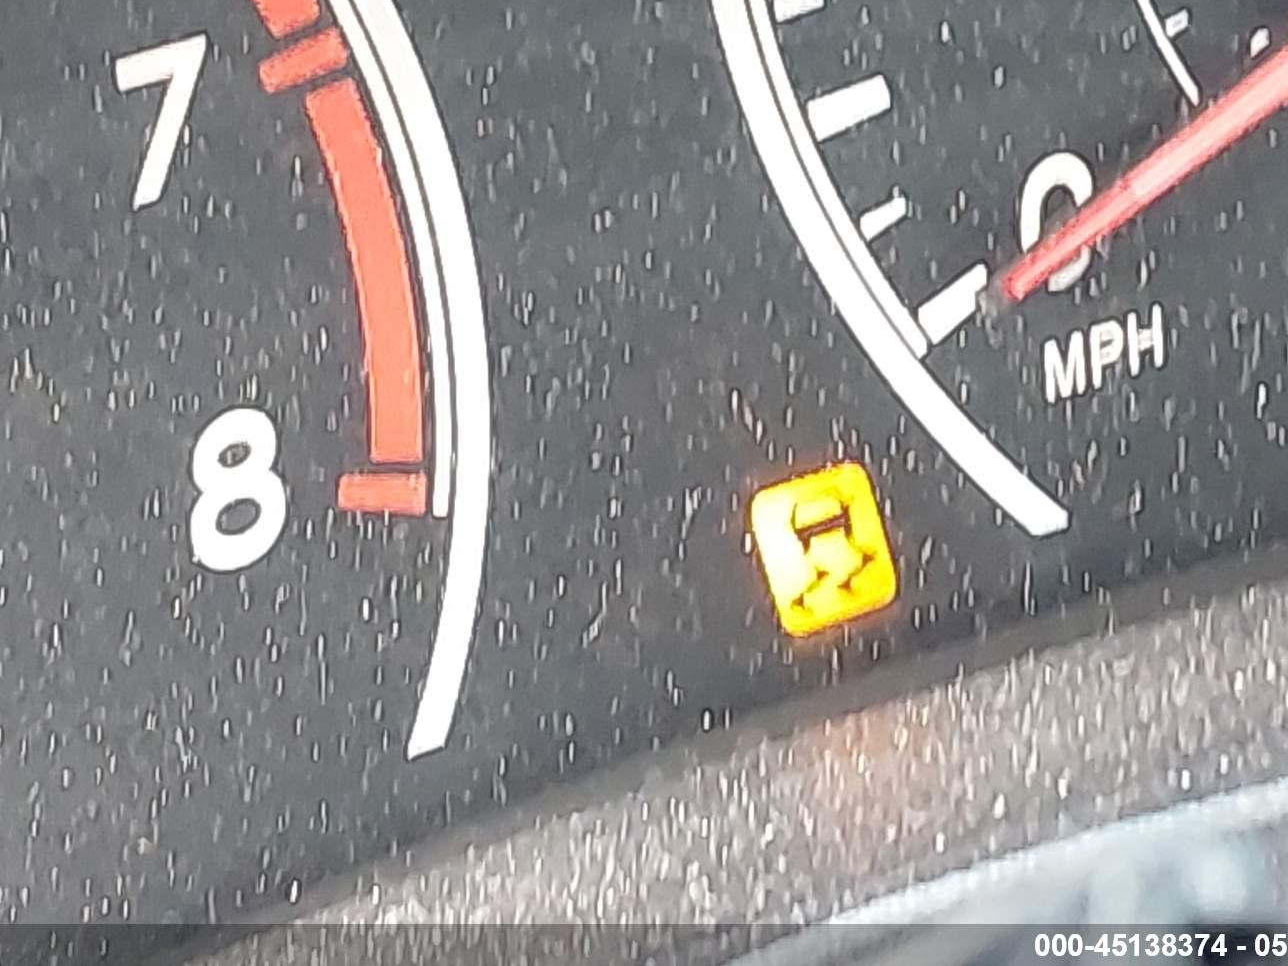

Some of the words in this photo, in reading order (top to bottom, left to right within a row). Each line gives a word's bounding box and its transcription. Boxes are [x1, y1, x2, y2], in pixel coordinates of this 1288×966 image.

[114, 34, 207, 211] 7
[1019, 151, 1094, 293] 0
[1042, 303, 1165, 404] MPH
[188, 407, 287, 574] 8
